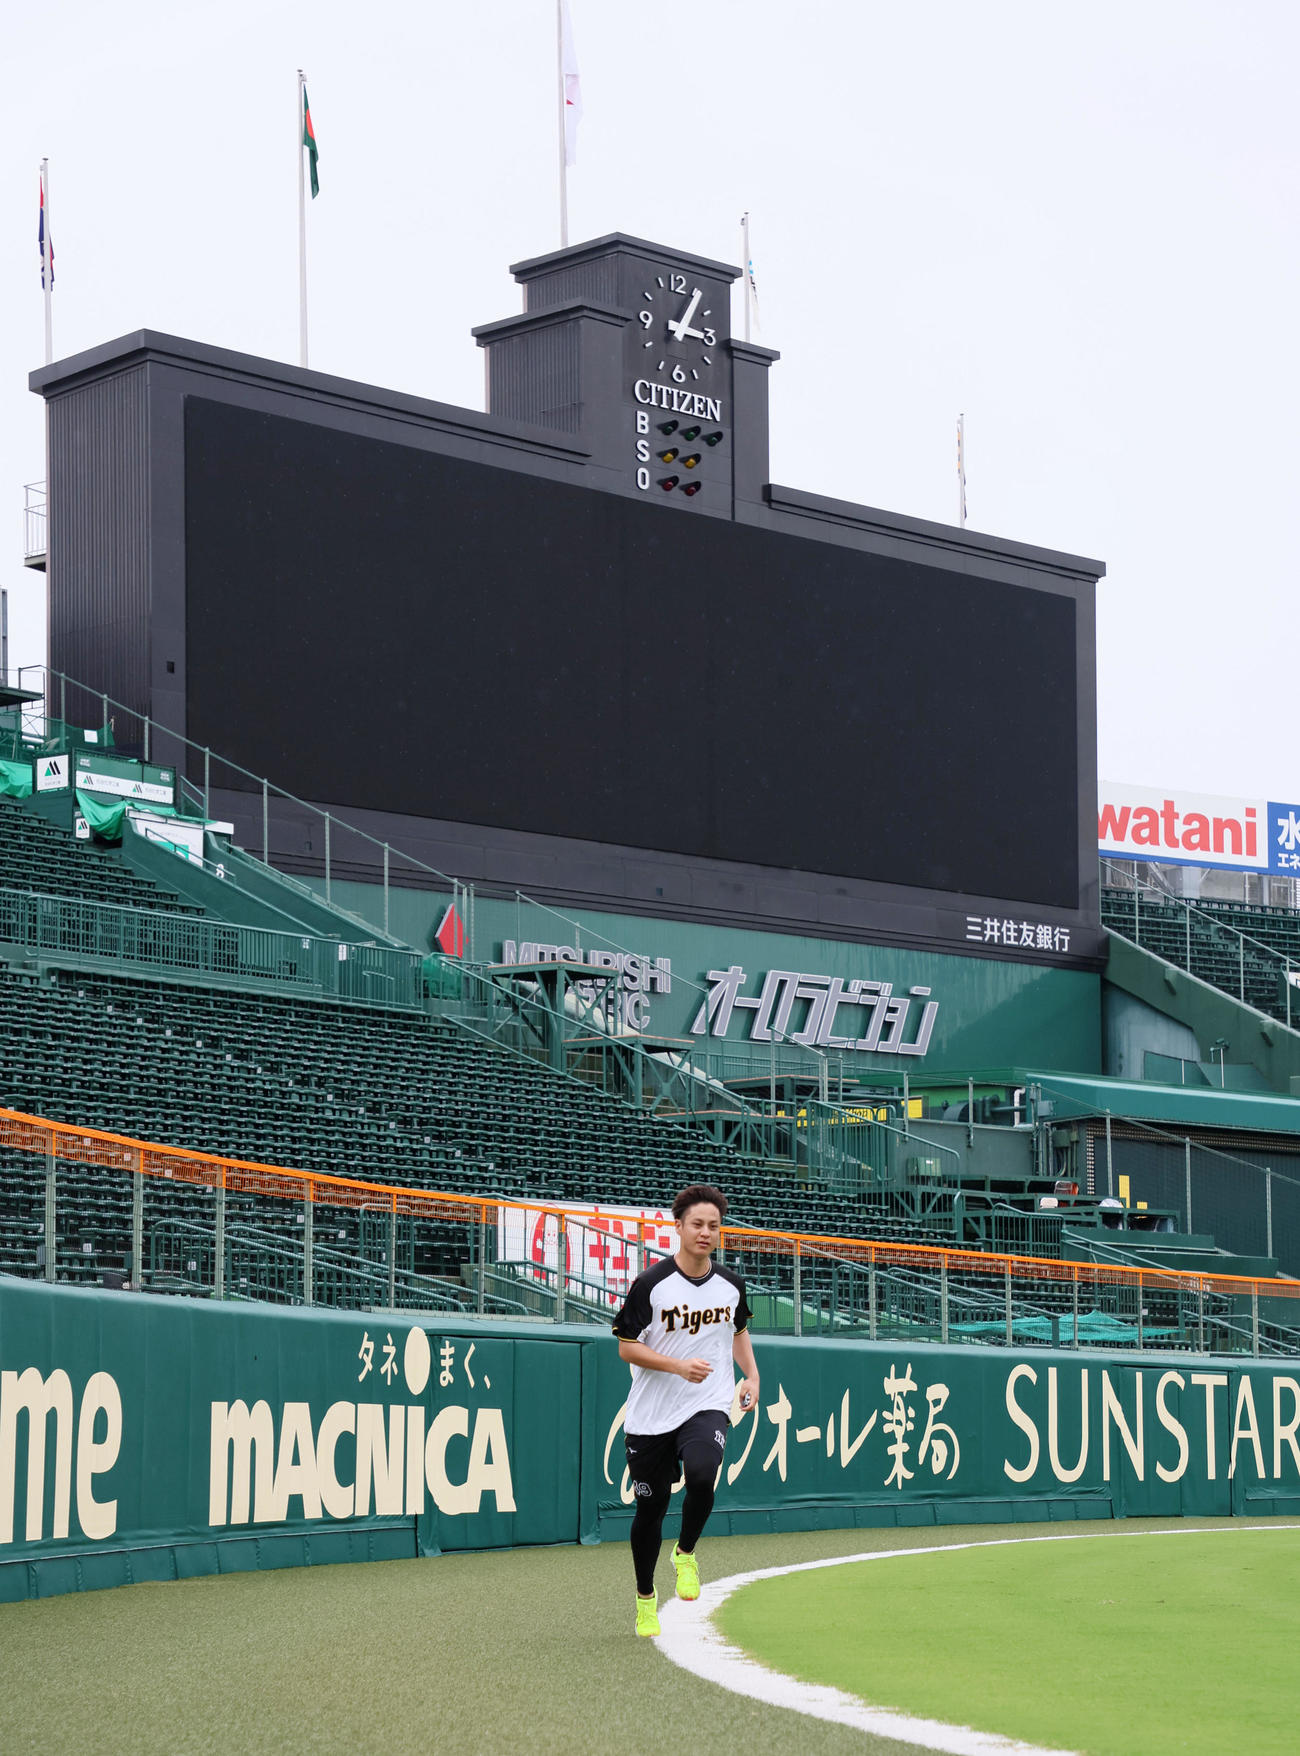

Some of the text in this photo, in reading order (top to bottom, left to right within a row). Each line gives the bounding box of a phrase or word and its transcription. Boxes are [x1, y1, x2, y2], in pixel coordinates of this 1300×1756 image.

[670, 273, 687, 294] 12
[639, 311, 652, 329] 9
[703, 327, 716, 346] 3
[672, 364, 685, 382] 6
[634, 379, 722, 422] CITIZEN
[636, 410, 650, 434] B
[636, 439, 650, 462] S
[966, 916, 1070, 952] 三井住友銀行
[690, 966, 939, 1055] オーロラビジョン
[661, 1304, 731, 1335] Tigers
[1003, 1363, 1300, 1483] SUNSTAR
